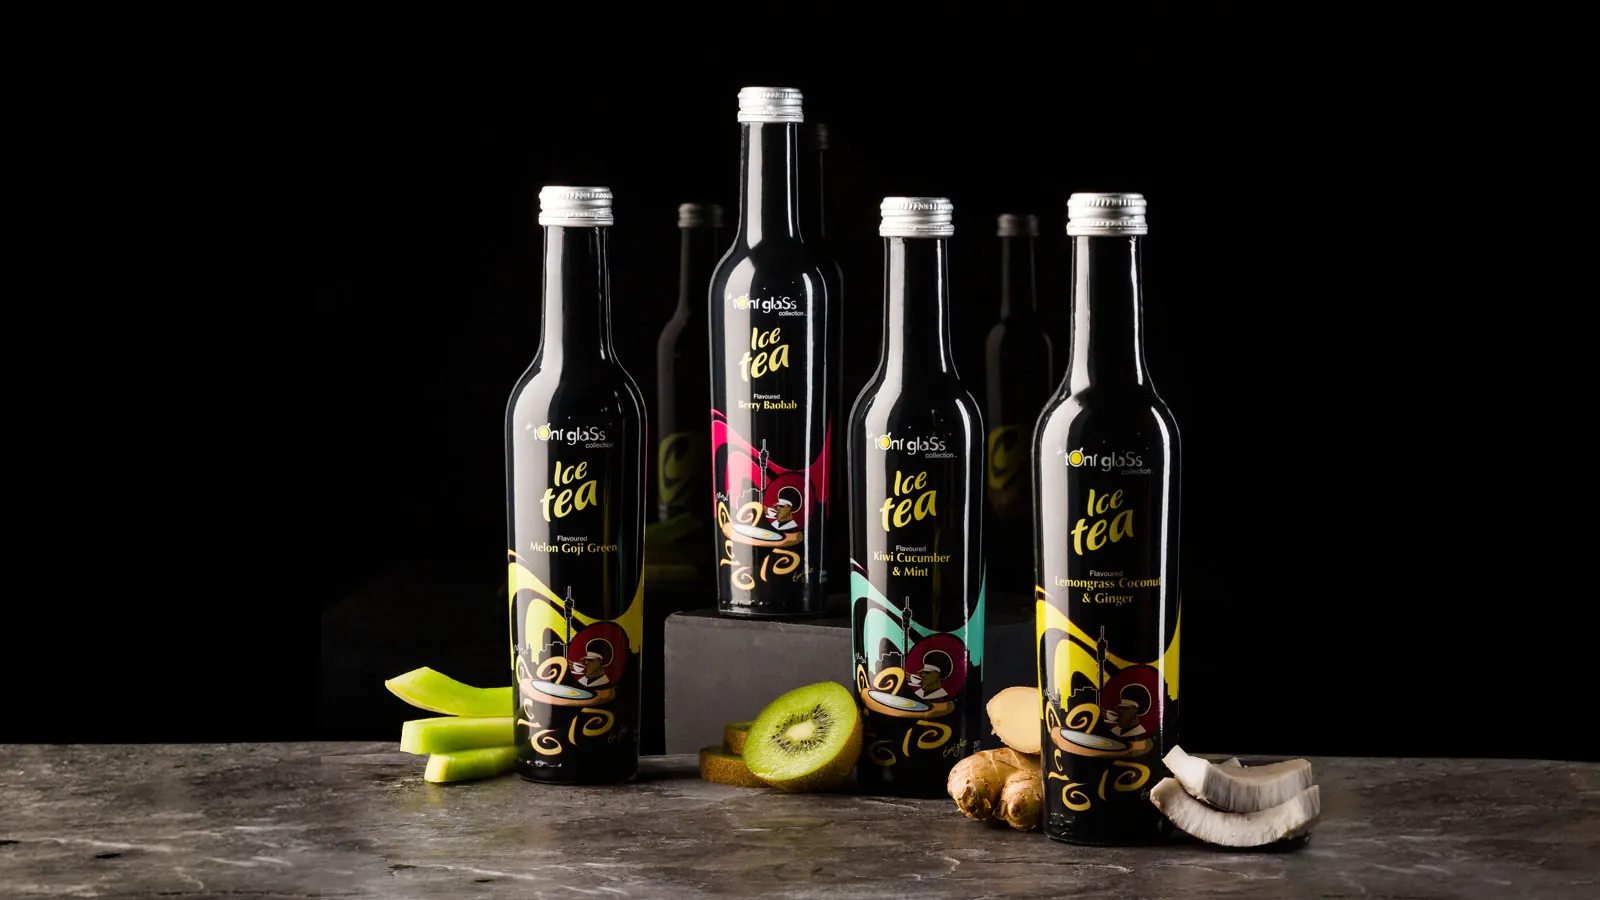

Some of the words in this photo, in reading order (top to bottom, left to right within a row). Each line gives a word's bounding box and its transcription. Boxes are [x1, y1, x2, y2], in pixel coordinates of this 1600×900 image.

[751, 327, 781, 351] Ice
[738, 344, 790, 382] tea
[738, 400, 761, 411] Berry
[763, 400, 798, 410] Baobab
[554, 460, 588, 487] Ice
[893, 470, 928, 497] Ice
[540, 479, 598, 523] tea
[879, 490, 937, 532] tea
[1087, 488, 1124, 517] Ice
[1070, 509, 1134, 556] tea
[530, 542, 559, 553] Melon
[561, 542, 584, 556] Goji
[587, 542, 618, 553] Green
[873, 551, 894, 562] Kiwi
[896, 552, 951, 563] Cucumber
[892, 566, 901, 576] &
[903, 566, 929, 577] Mint
[1055, 575, 1115, 591] Lemongrass
[1089, 569, 1124, 578] Flavoured
[1081, 592, 1092, 604] &
[1094, 592, 1134, 607] Ginger
